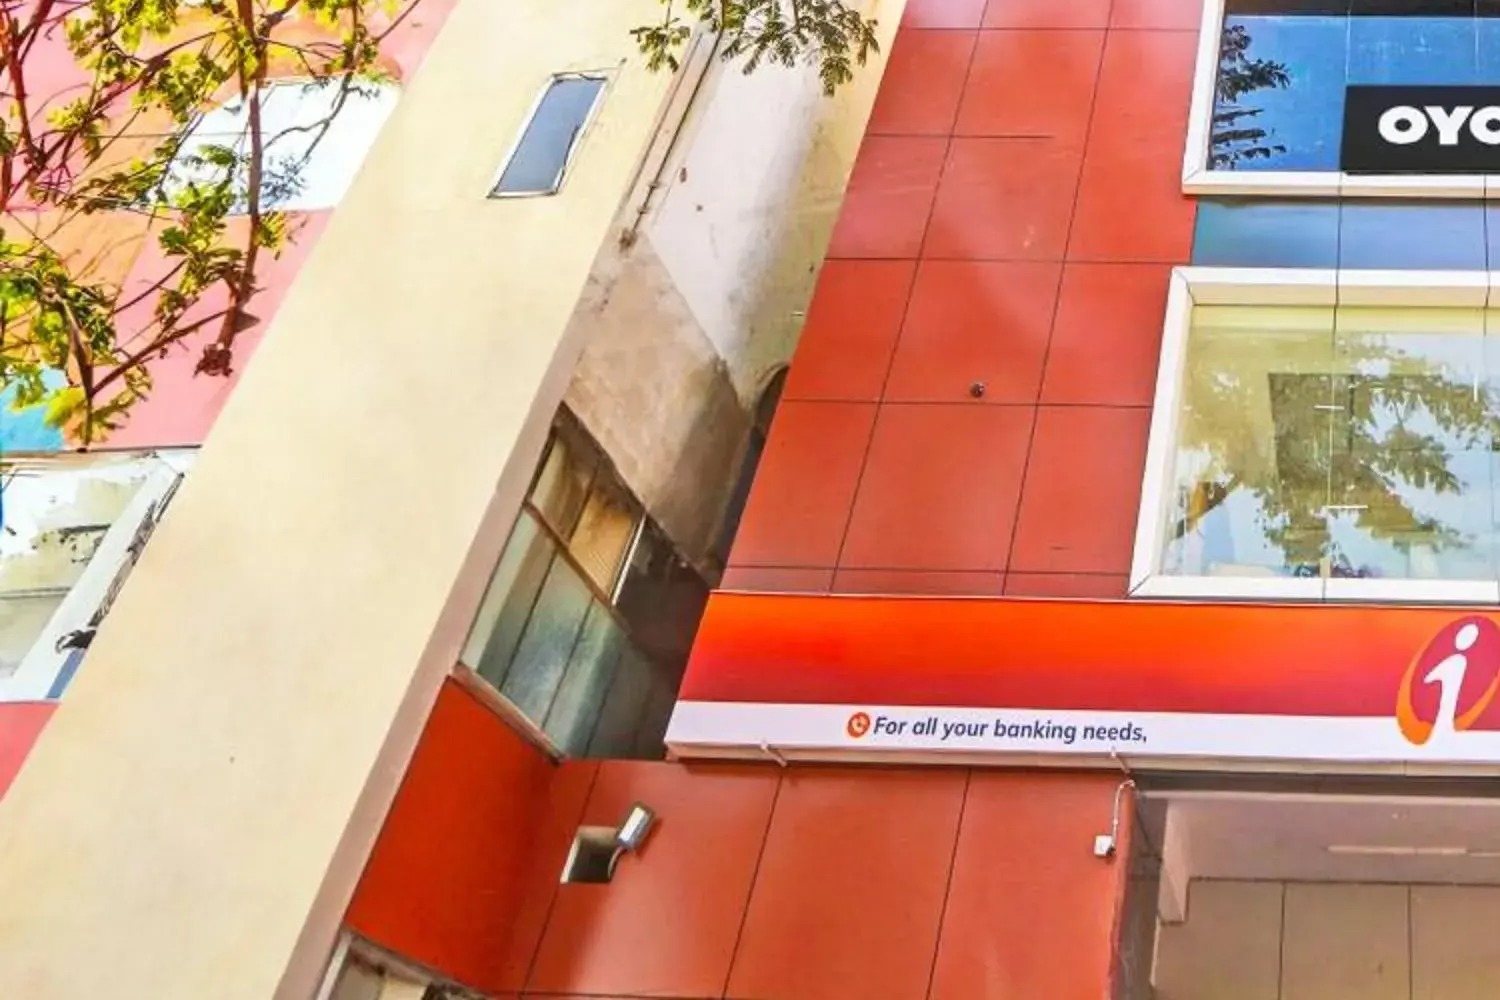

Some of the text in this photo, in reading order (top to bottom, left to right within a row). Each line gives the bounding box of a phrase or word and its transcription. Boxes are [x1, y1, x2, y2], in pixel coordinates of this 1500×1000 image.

[873, 716, 1148, 744] For all your banking needs,
